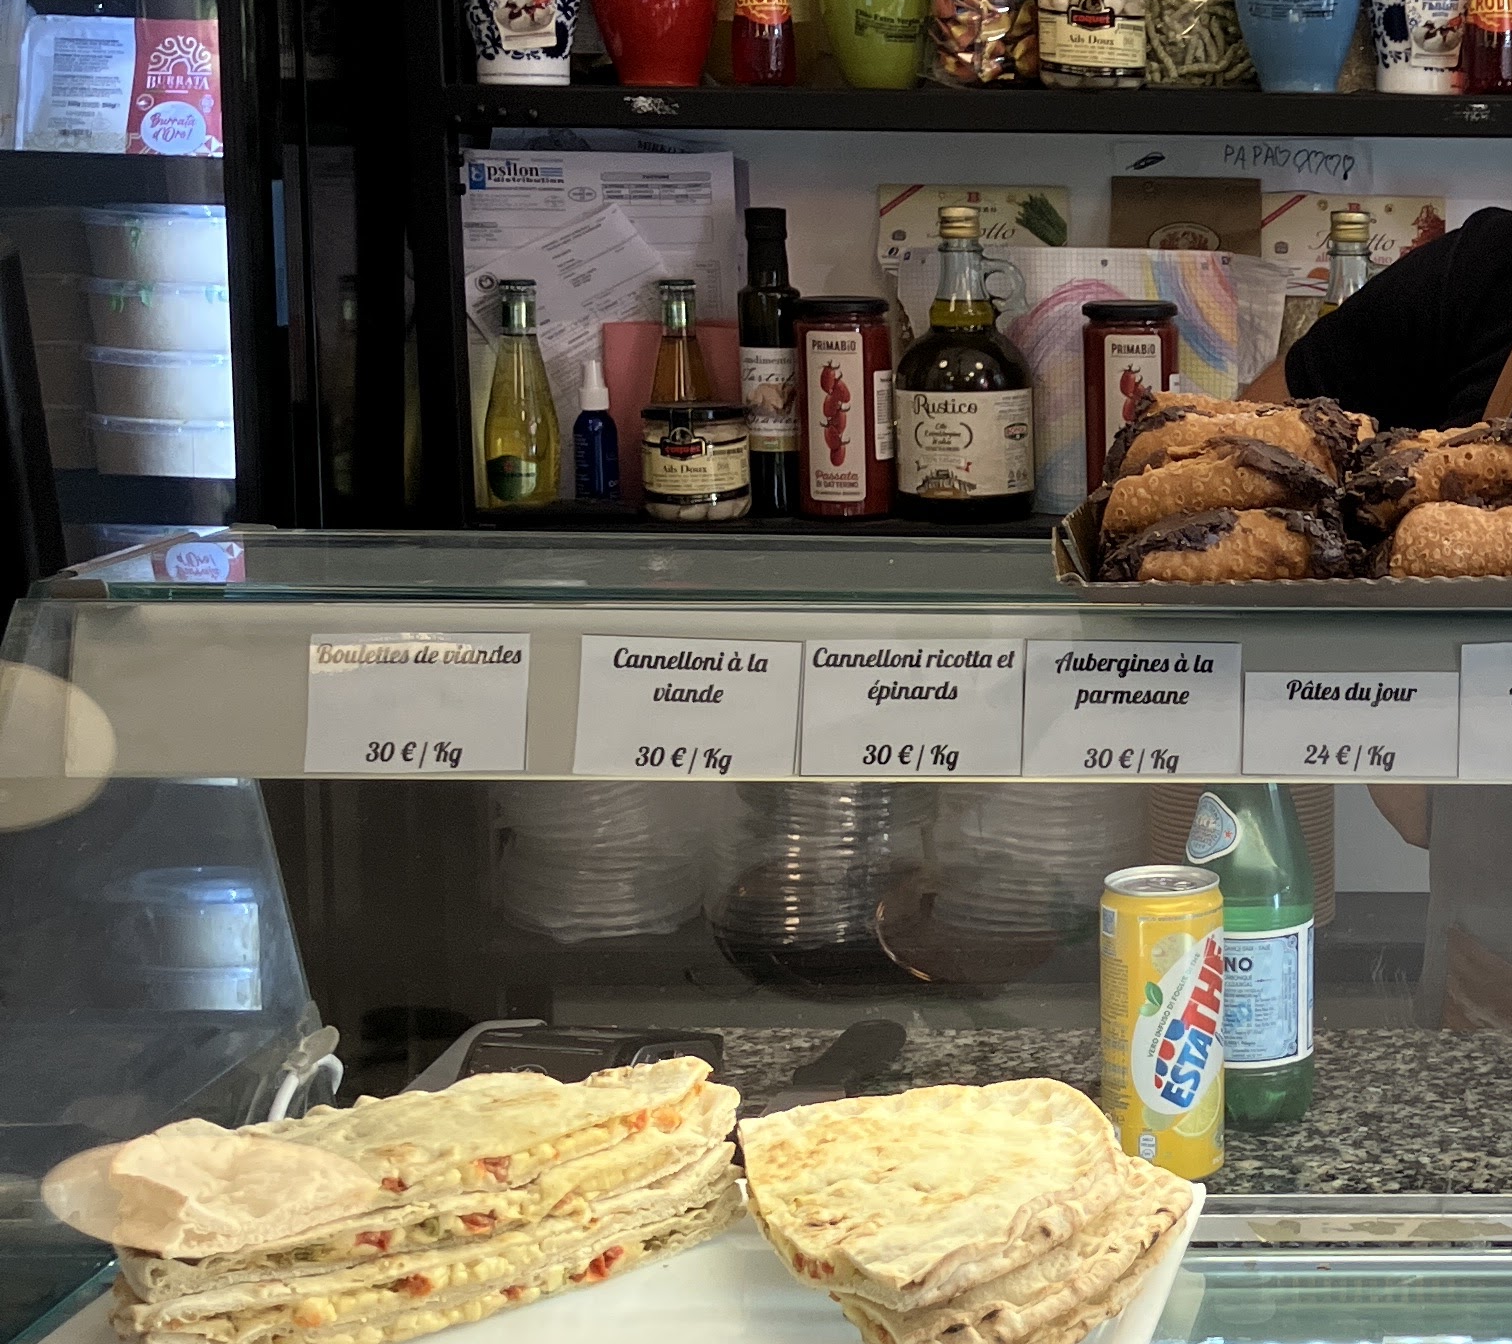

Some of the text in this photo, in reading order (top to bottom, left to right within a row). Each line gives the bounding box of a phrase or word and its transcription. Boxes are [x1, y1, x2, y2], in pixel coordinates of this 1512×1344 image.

[150, 112, 196, 128] Burrata
[913, 393, 978, 419] Rustico
[317, 643, 523, 666] Boulettes de viandes
[613, 647, 769, 674] Cannelloni à la
[812, 646, 1016, 670] Cannelloni ricotta et
[1055, 651, 1215, 678] Aubergines à la
[653, 683, 725, 704] viande
[867, 679, 959, 707] épinards
[1074, 688, 1190, 710] parmesane
[1285, 678, 1418, 708] Pâtes du jour
[365, 739, 463, 768] 30 € / Kg
[635, 745, 733, 775] 30 € / Kg
[862, 742, 960, 772] 30 € / Kg
[1083, 747, 1180, 775] 30 € / Kg
[1303, 742, 1397, 772] 24 € / Kg
